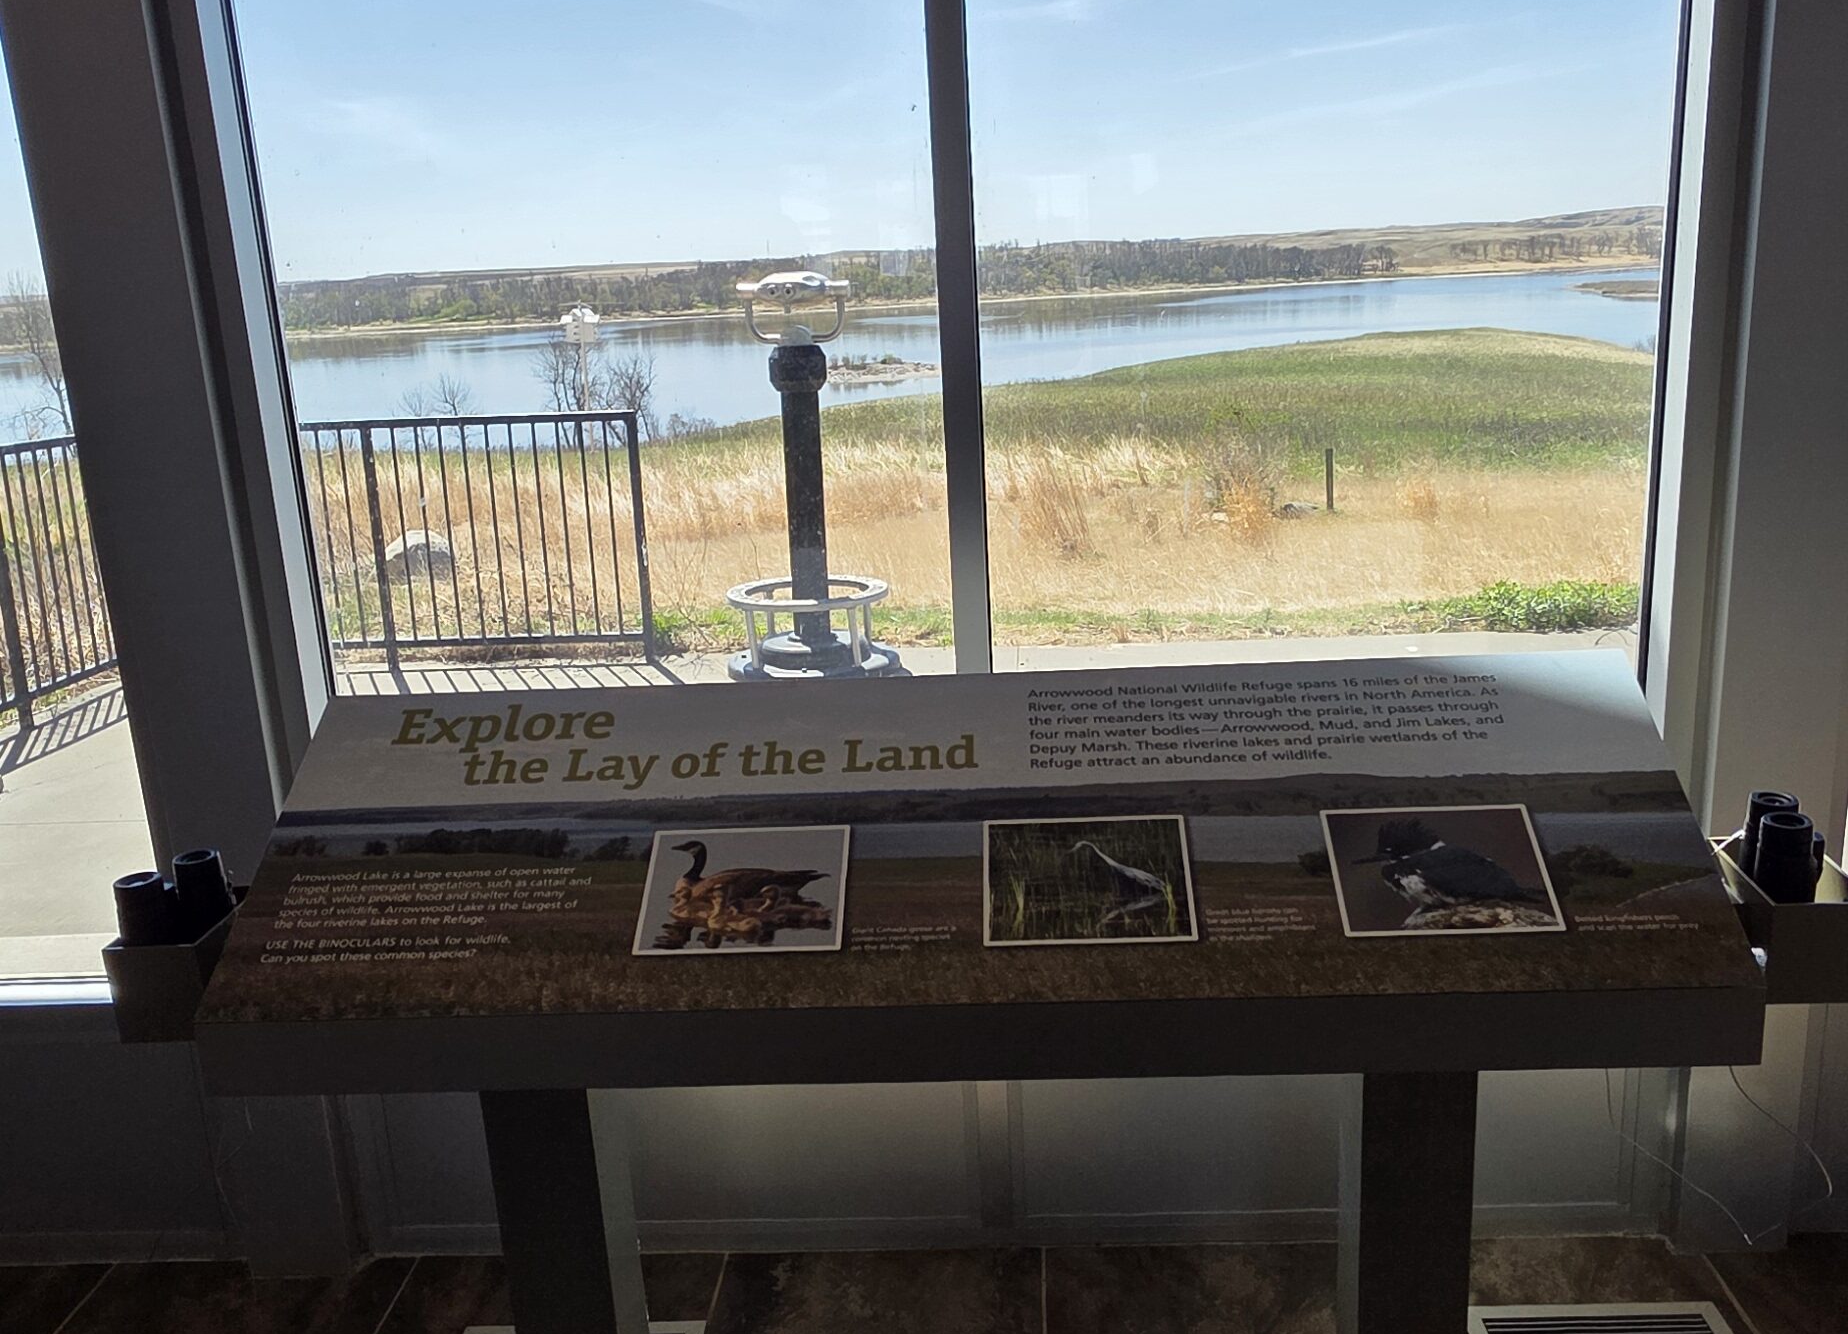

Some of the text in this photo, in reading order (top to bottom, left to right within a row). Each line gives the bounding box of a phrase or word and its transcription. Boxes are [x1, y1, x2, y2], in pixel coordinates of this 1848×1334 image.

[1027, 674, 1497, 698] Arrowwood National Wildlife Refuge spans 16 miles of the James
[1028, 686, 1498, 713] River, one of the longest unnavigable rivers in North America. As
[1028, 699, 1498, 726] the river meanders its way through the prairie, it passes through
[390, 703, 615, 754] Explore
[1029, 729, 1059, 739] four
[1064, 727, 1100, 739] main
[1103, 727, 1146, 737] water
[1318, 718, 1358, 730] Mud,
[1362, 717, 1391, 728] and
[1396, 717, 1421, 728] Jim
[1424, 715, 1470, 726] Lakes,
[1475, 713, 1504, 724] and
[1029, 729, 1487, 755] Depuy Marsh. These riverine lakes and prairie wetlands of the
[462, 733, 979, 790] the Lay of the Land
[1030, 748, 1332, 770] Refuge attract an abundance of wildlife.
[291, 866, 575, 882] Arrowwood Lake is a large expanse of open water
[287, 883, 330, 895] fringed
[332, 883, 358, 893] with
[359, 882, 416, 893] emergent
[486, 878, 512, 888] such
[514, 879, 527, 887] as
[527, 876, 566, 889] cattail
[568, 876, 592, 886] and
[331, 893, 365, 903] which
[367, 892, 412, 904] provide
[414, 890, 443, 901] food
[444, 890, 469, 900] and
[470, 890, 509, 899] shelter
[512, 889, 529, 898] for
[532, 890, 565, 899] many
[278, 898, 578, 918] species of wildlife. Arrowwood Lake is the largest of
[274, 914, 487, 928] the four riverine lakes on the Refuge.
[265, 933, 510, 949] USE THE BINOCULARS to look for wildlife.
[260, 948, 477, 965] Can you spot these common species?
